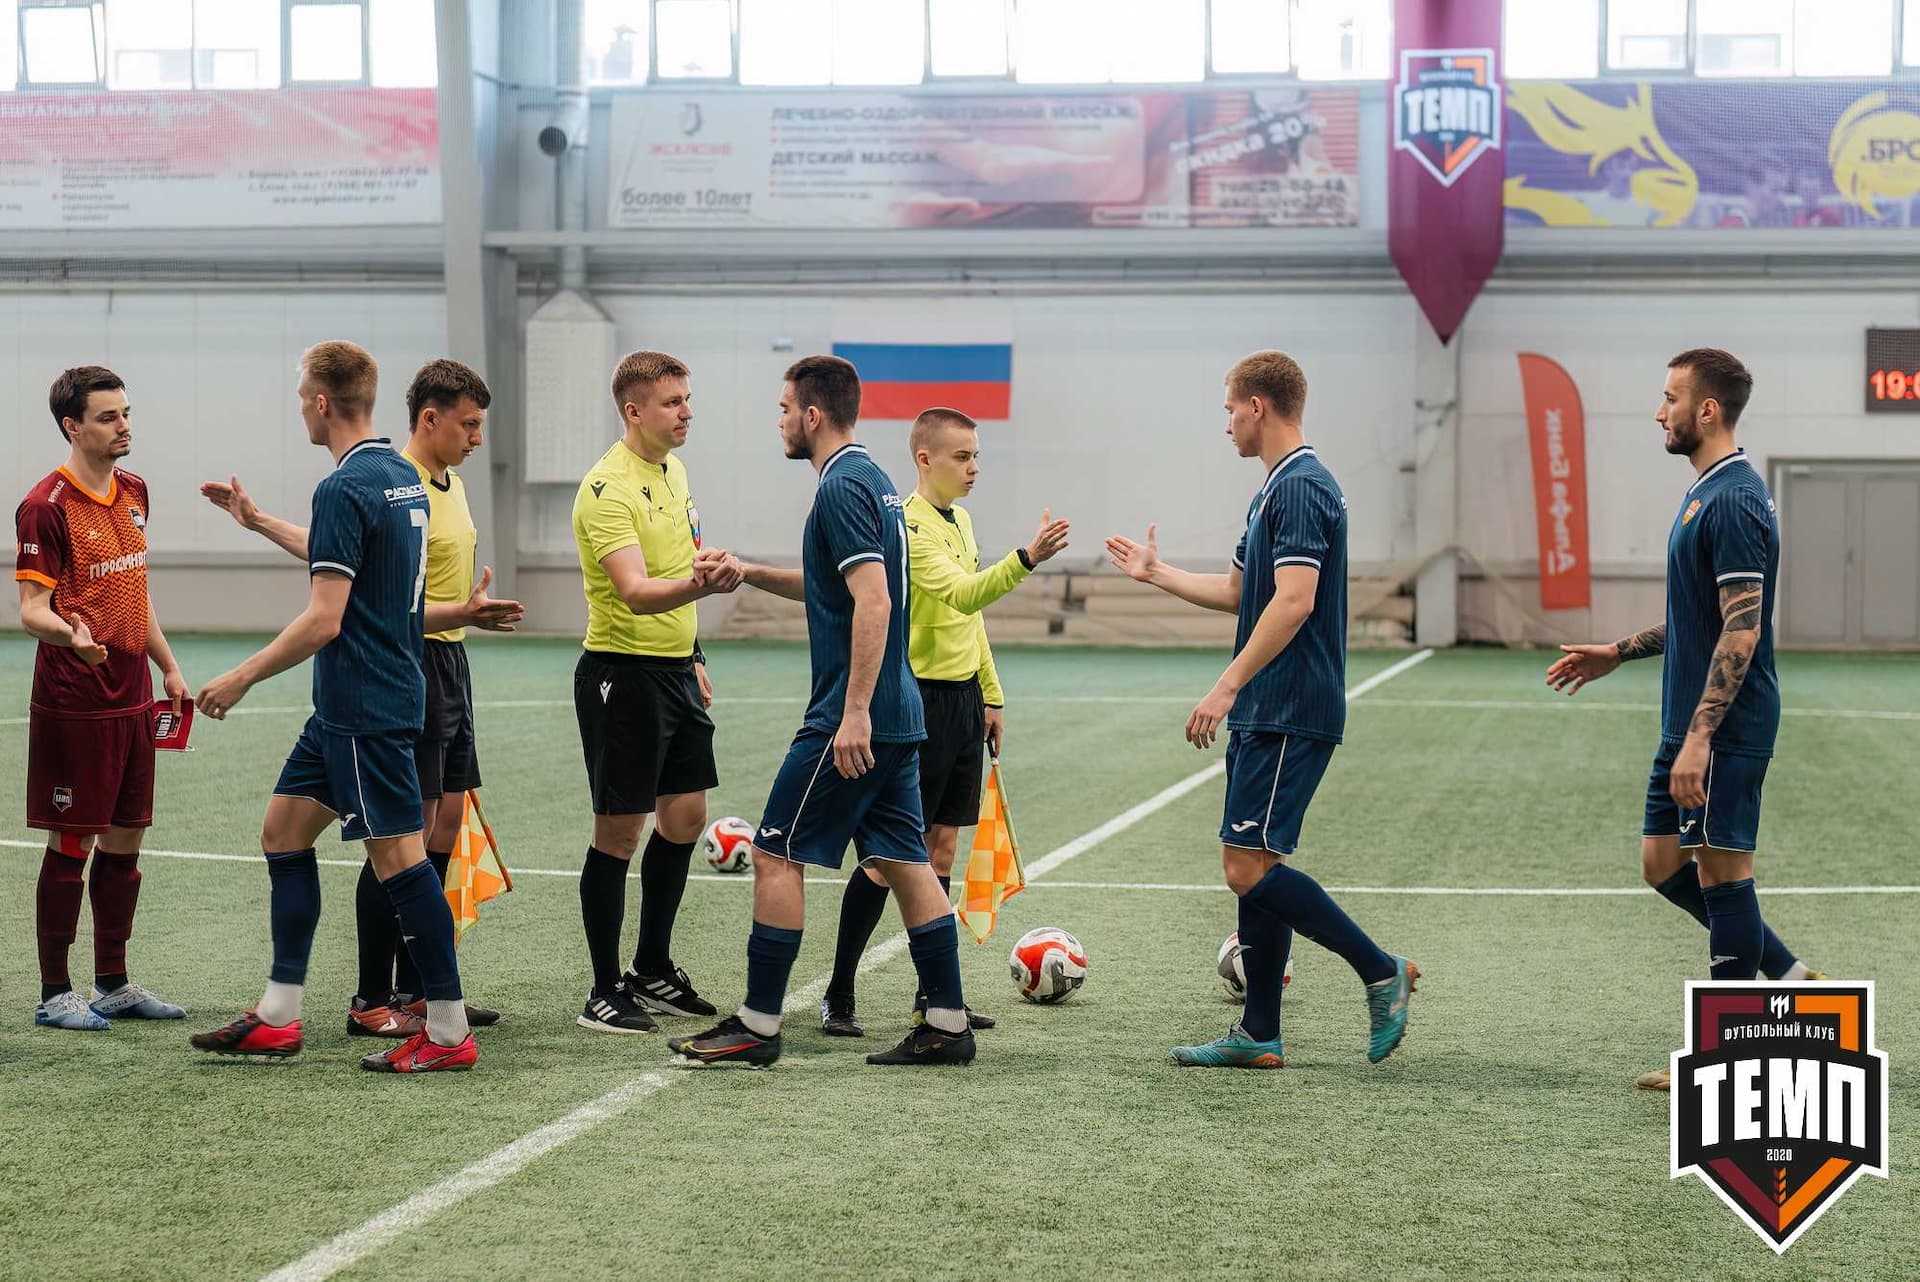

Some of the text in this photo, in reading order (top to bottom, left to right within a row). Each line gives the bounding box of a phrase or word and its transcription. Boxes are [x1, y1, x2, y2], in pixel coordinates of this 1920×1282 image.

[1404, 86, 1491, 135] ТЕМП
[771, 148, 939, 165] ДЕТСКИЙ МАССАЖ
[622, 187, 687, 206] более
